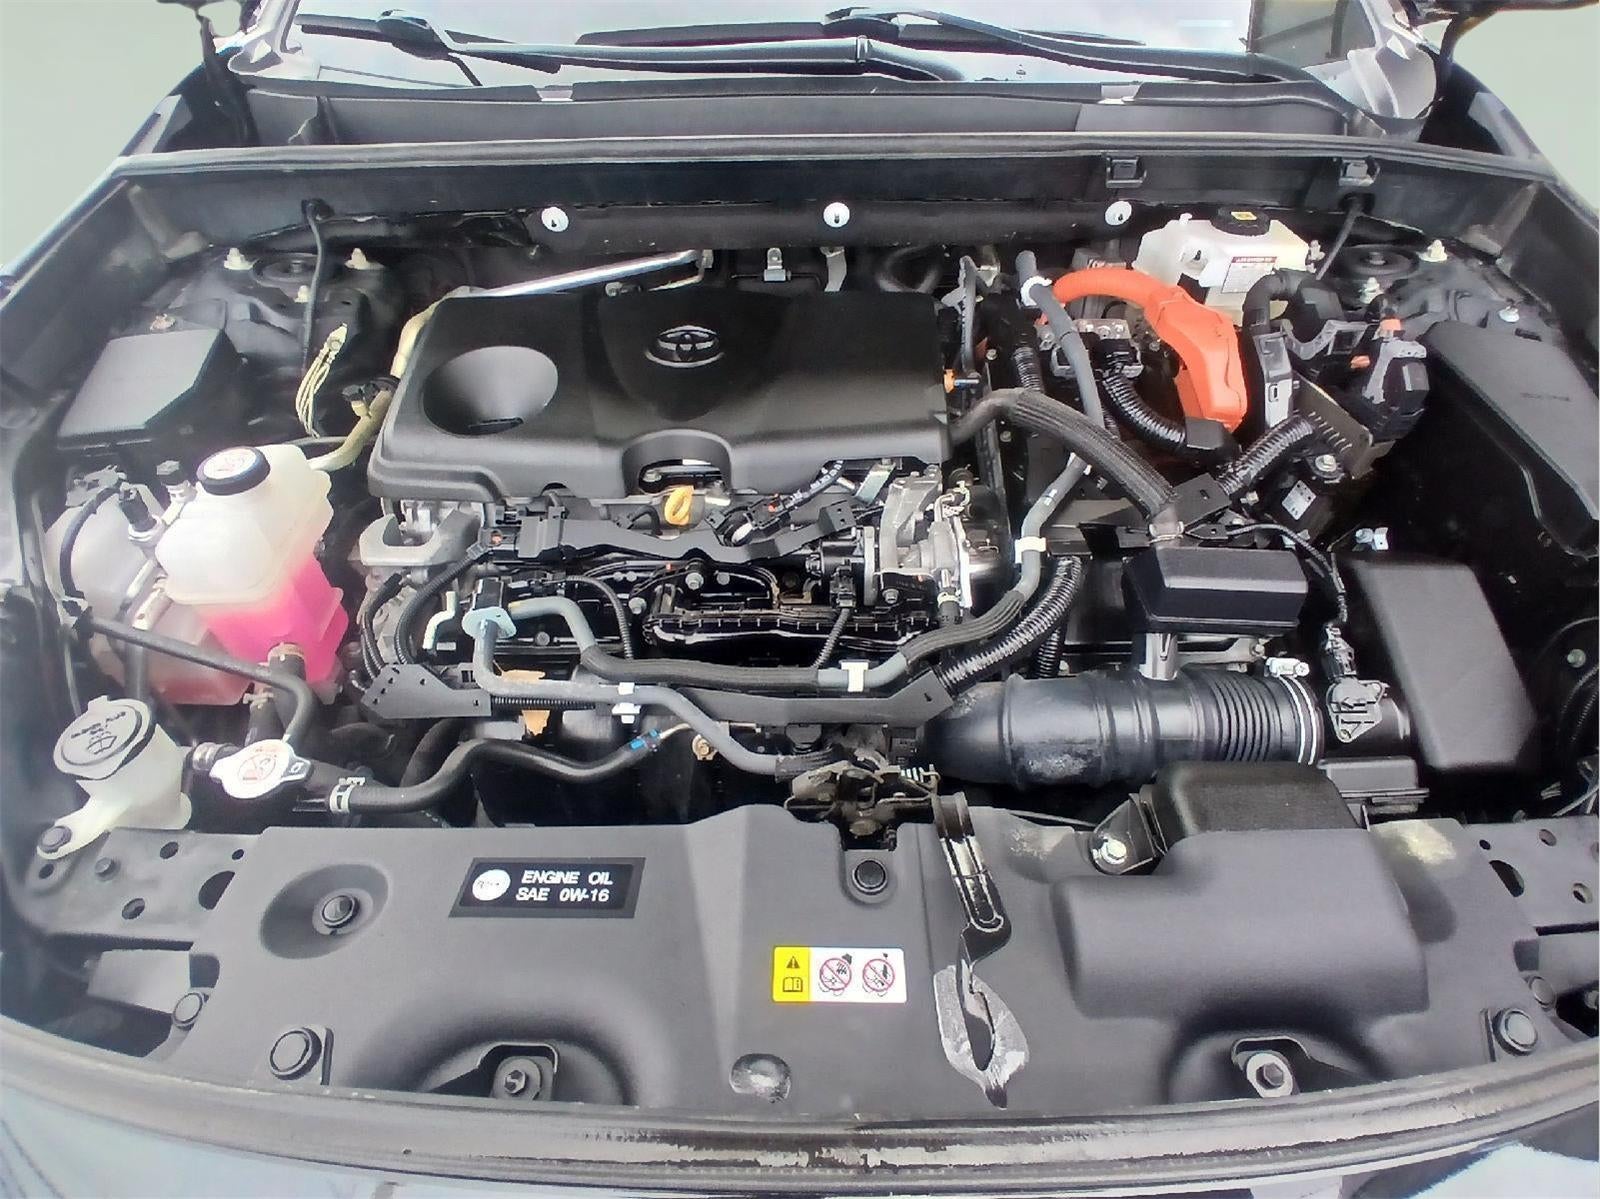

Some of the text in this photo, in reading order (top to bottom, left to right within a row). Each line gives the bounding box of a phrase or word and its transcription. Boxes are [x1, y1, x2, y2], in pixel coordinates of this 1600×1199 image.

[521, 869, 614, 886] ENGINE OIL
[515, 886, 610, 902] SAE 0W-16
